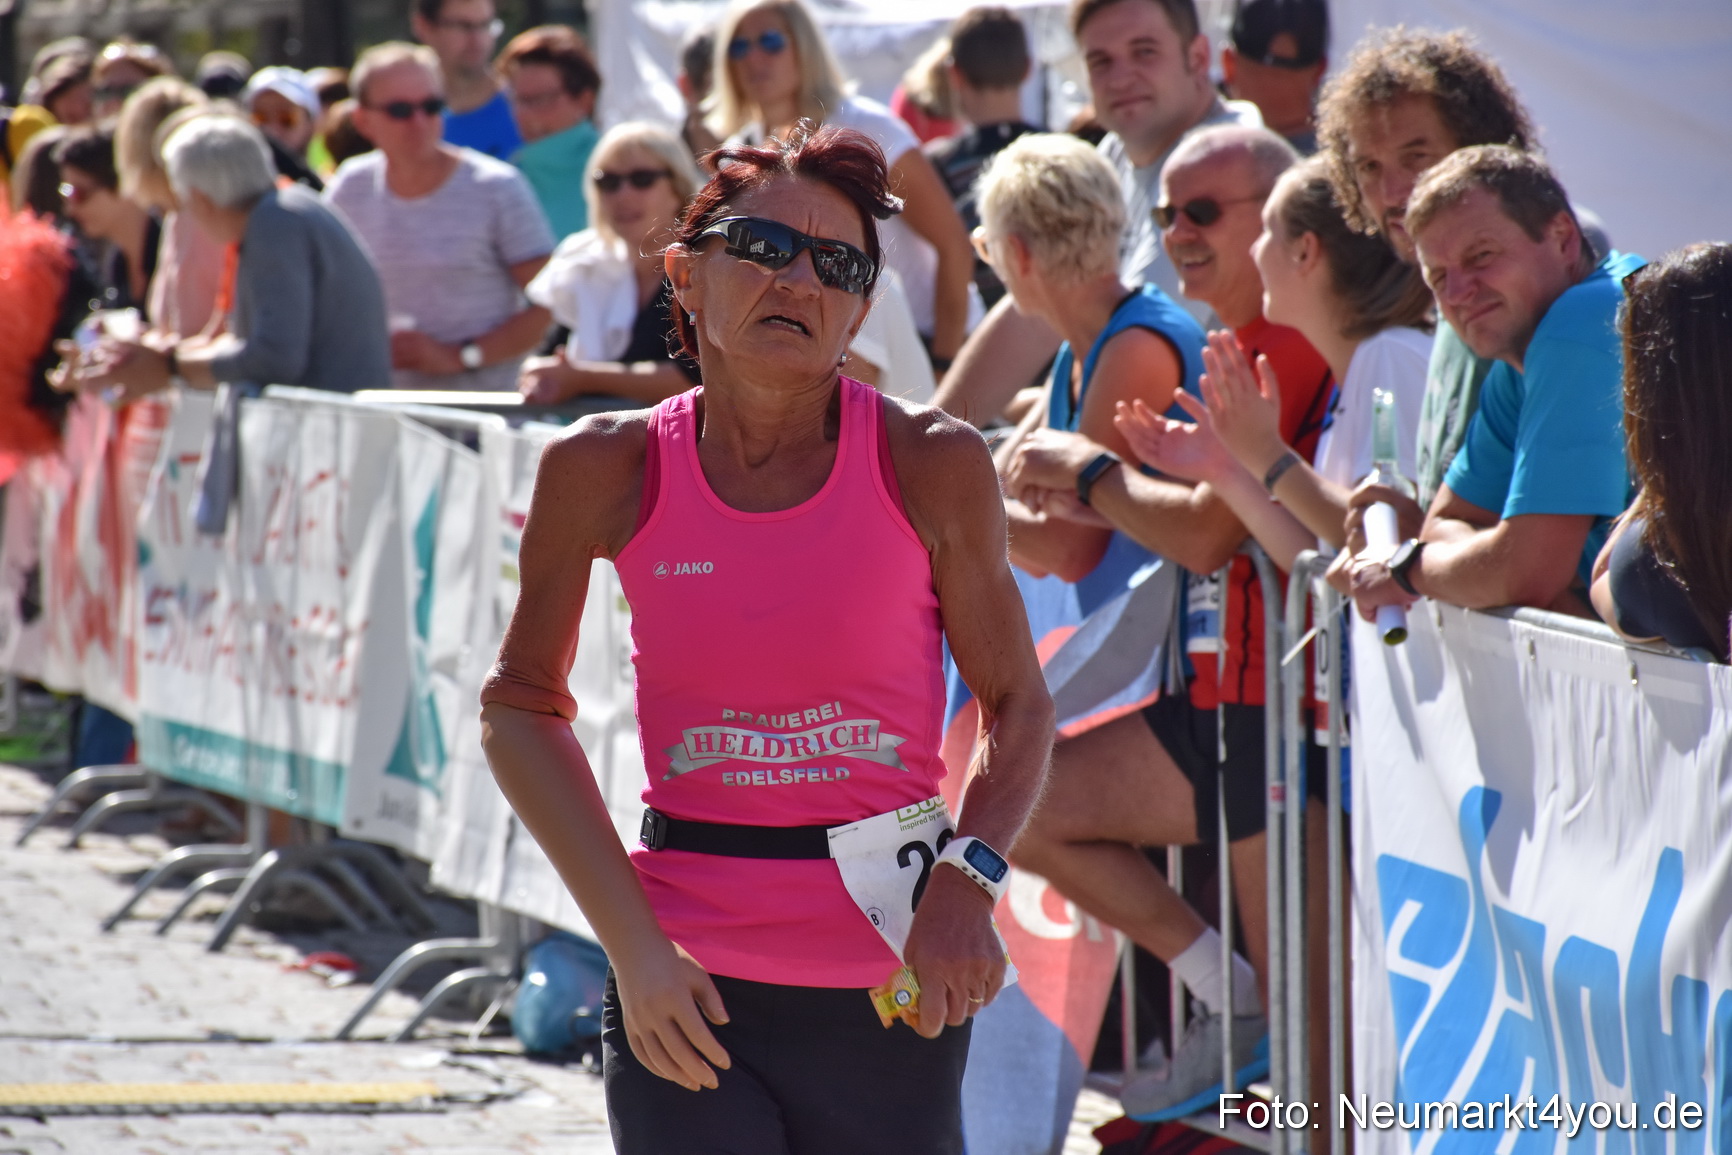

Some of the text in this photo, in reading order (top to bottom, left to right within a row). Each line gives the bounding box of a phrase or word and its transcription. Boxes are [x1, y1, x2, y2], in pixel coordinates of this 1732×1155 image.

[673, 561, 714, 576] JAKO
[721, 700, 844, 729] BRAUEREI
[691, 724, 872, 759] HELDRICH
[721, 766, 850, 787] EDELSFELD
[899, 815, 928, 832] inspired
[928, 812, 937, 822] by
[870, 913, 880, 926] B
